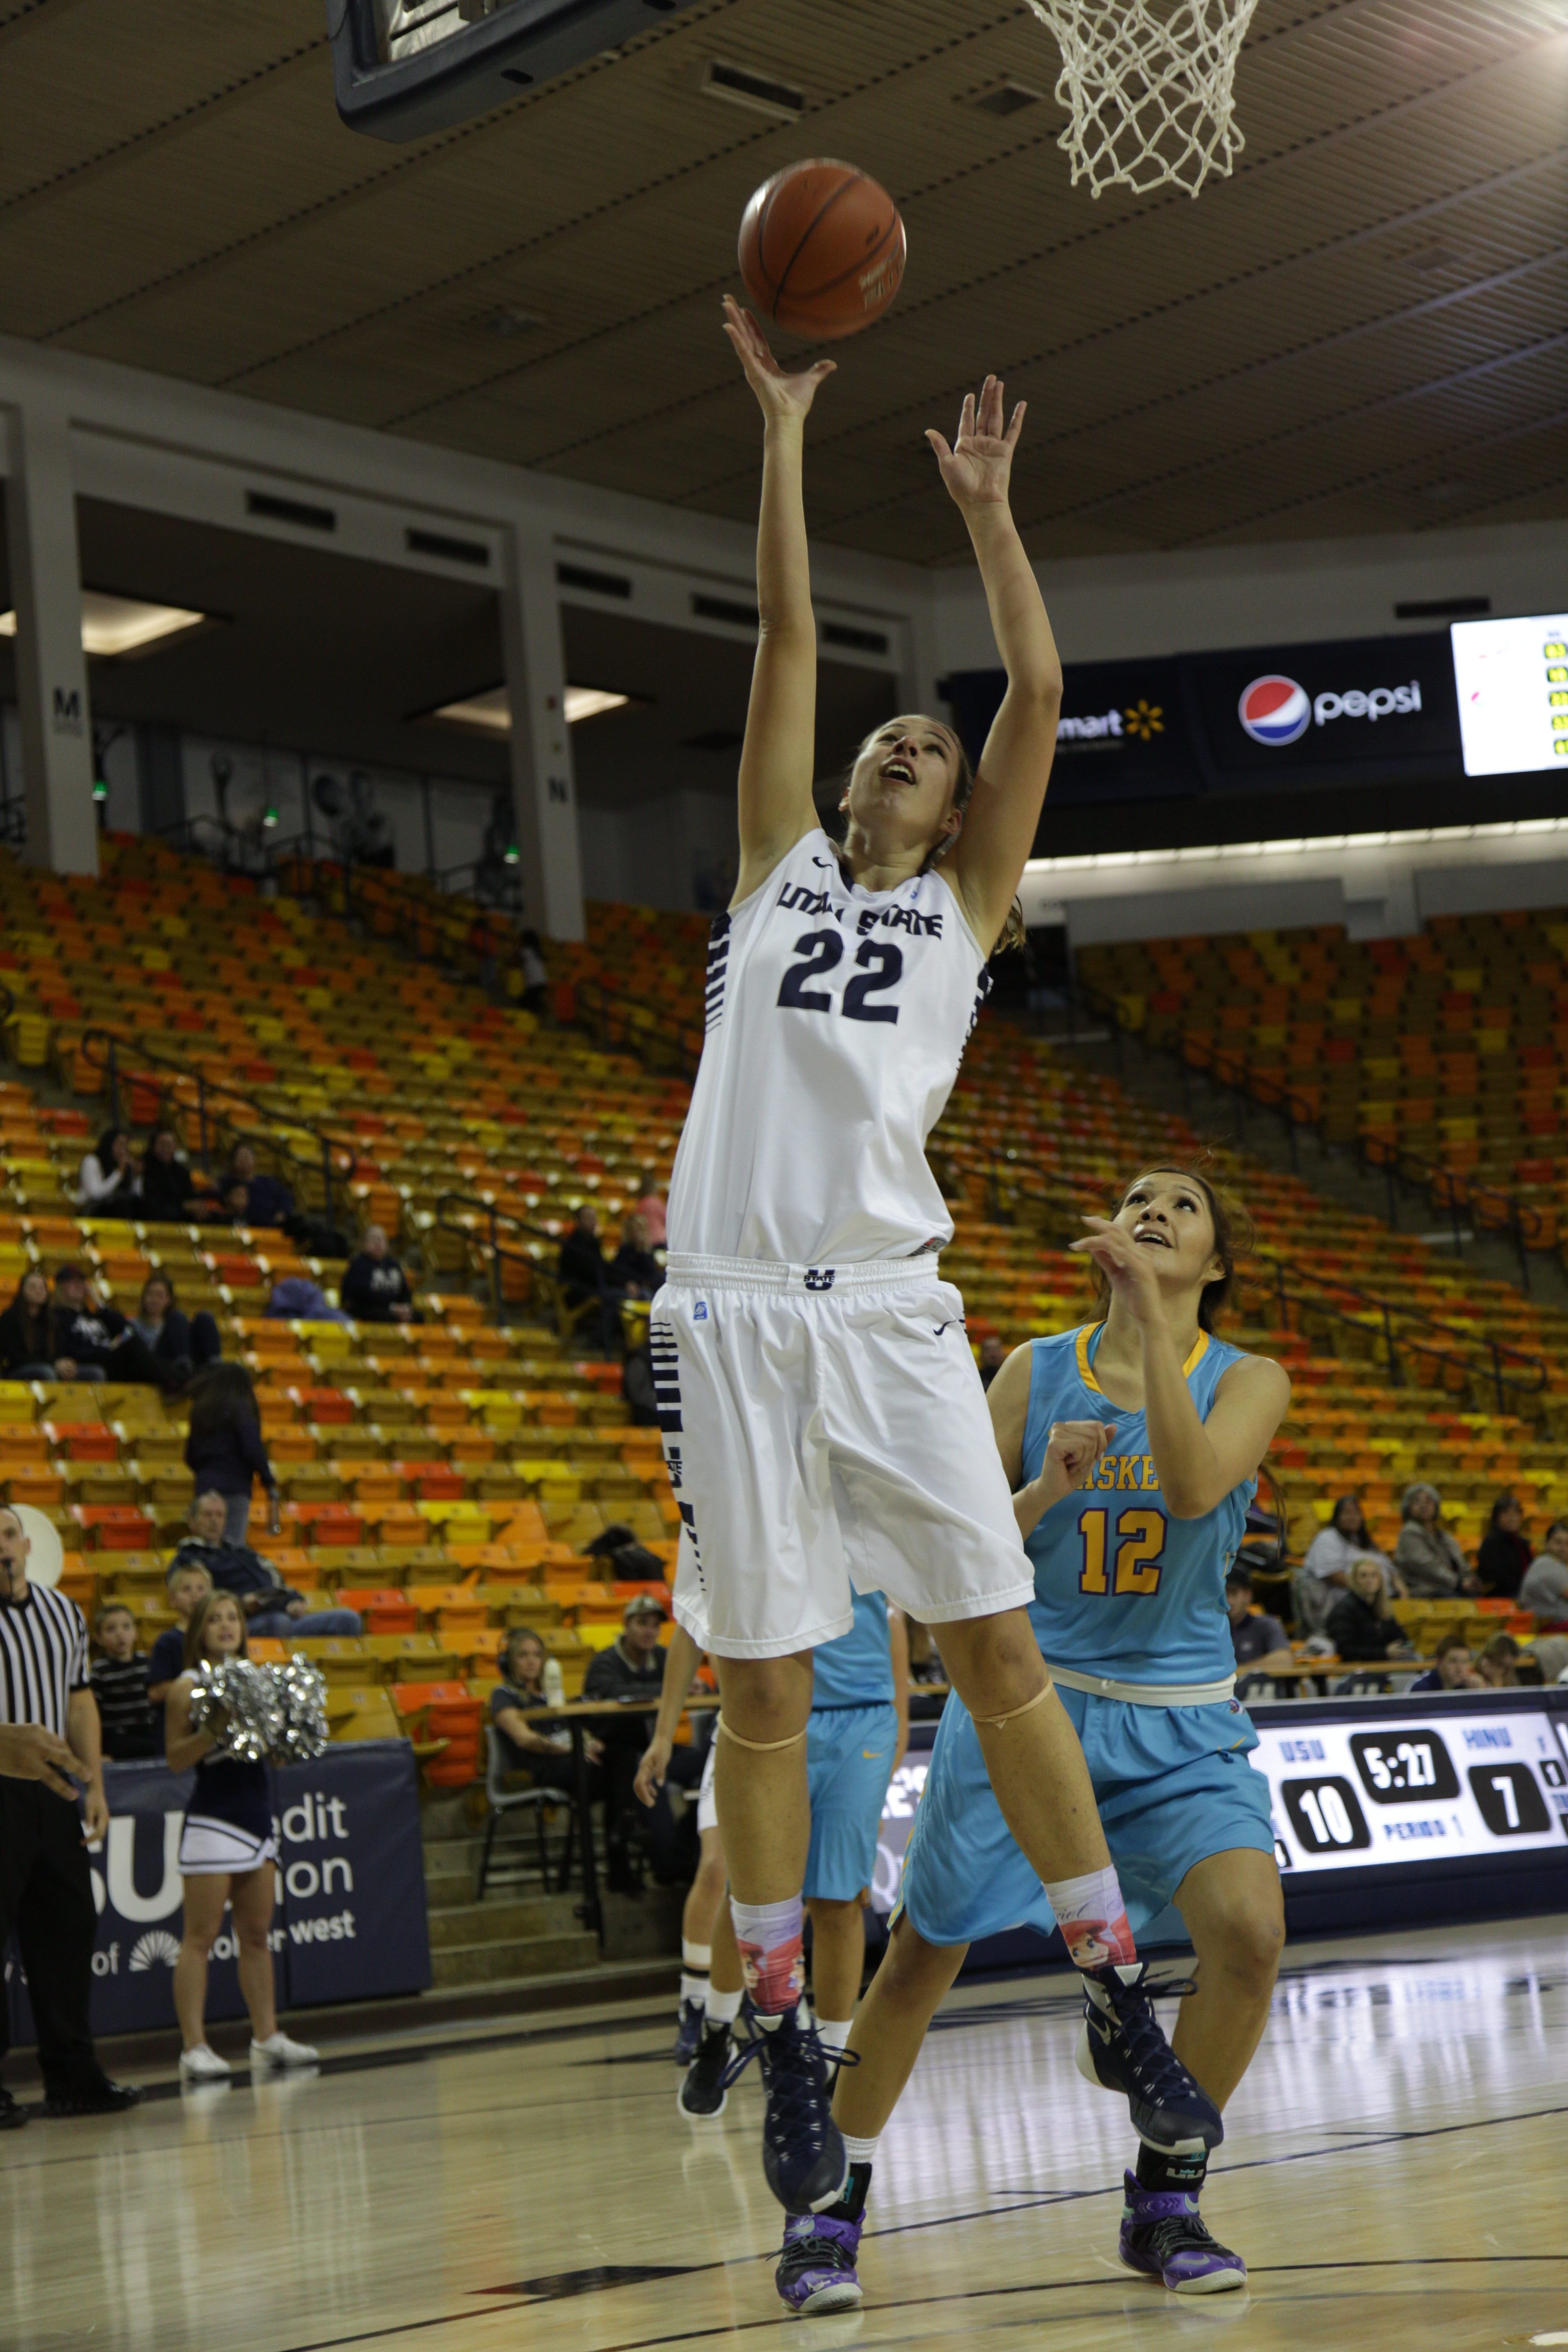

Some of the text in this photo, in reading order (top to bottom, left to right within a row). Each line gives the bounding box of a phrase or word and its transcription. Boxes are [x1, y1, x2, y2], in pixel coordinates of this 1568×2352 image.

[55, 686, 80, 718] M
[1057, 708, 1124, 740] mart
[1314, 679, 1422, 726] pepsi
[856, 903, 943, 940] STATE
[776, 929, 903, 1026] 22
[803, 1274, 835, 1283] STATE
[1078, 1507, 1168, 1597] 12
[1279, 1740, 1325, 1762] USU
[1362, 1742, 1437, 1789] 5:27
[271, 1791, 350, 1844] dit
[1298, 1785, 1354, 1844] 10
[1490, 1776, 1521, 1828] 7
[90, 1941, 120, 1976] of
